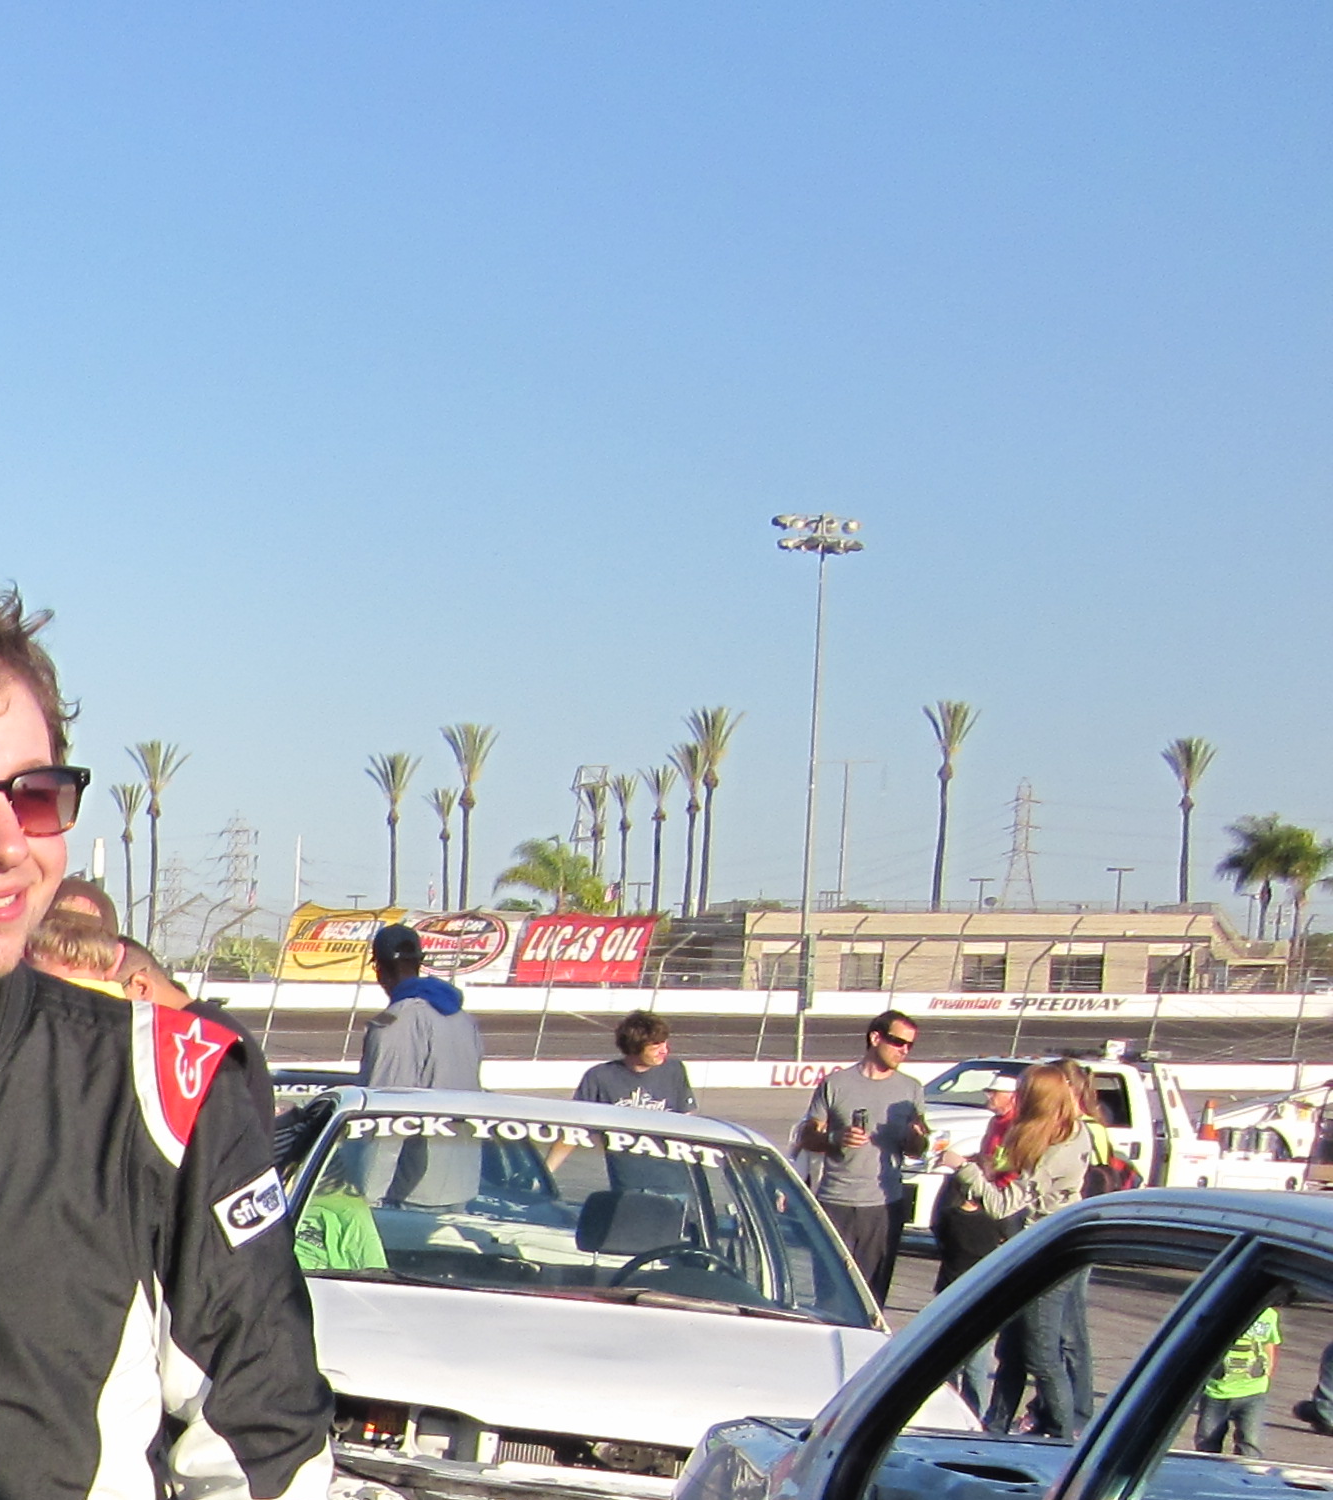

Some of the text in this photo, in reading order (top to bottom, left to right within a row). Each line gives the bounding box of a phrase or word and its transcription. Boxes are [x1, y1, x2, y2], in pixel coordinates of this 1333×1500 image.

[521, 924, 645, 963] LUCAS OIL
[1007, 998, 1128, 1012] SPEEDWAY
[770, 1065, 842, 1086] LUCA
[346, 1115, 727, 1170] PICK YOUR PART
